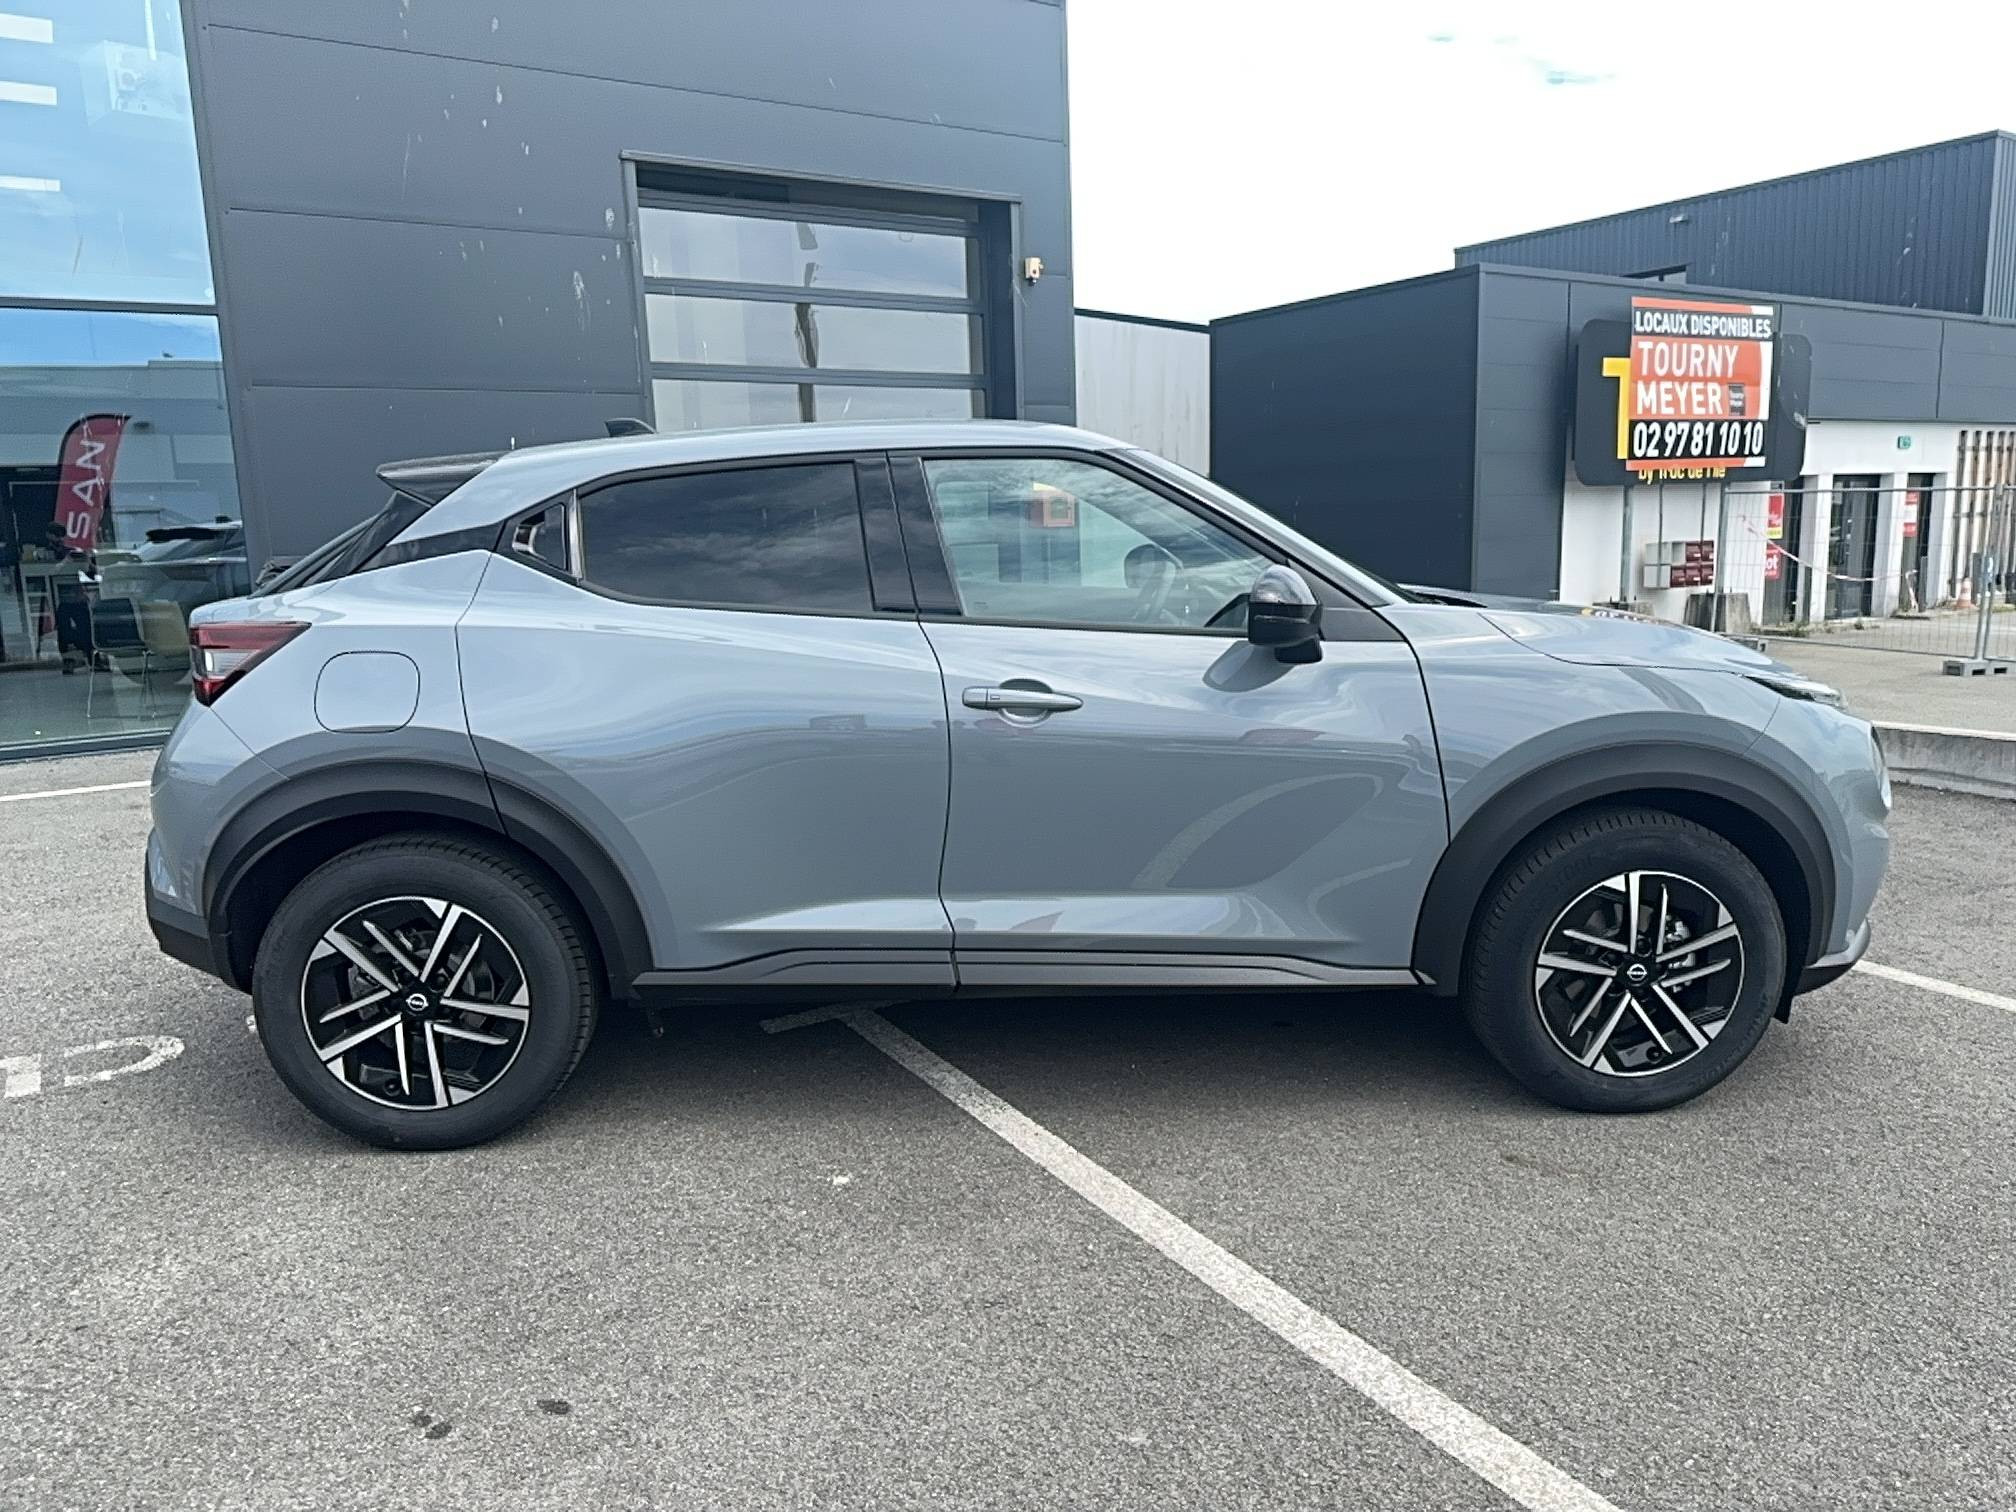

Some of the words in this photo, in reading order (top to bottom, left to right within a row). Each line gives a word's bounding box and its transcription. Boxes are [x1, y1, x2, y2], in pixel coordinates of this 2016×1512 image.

[1635, 310, 1689, 333] LOCAUX
[1691, 315, 1772, 338] DISPONIBLES
[1638, 341, 1739, 378] TOURNY
[1637, 380, 1723, 415] MEYER
